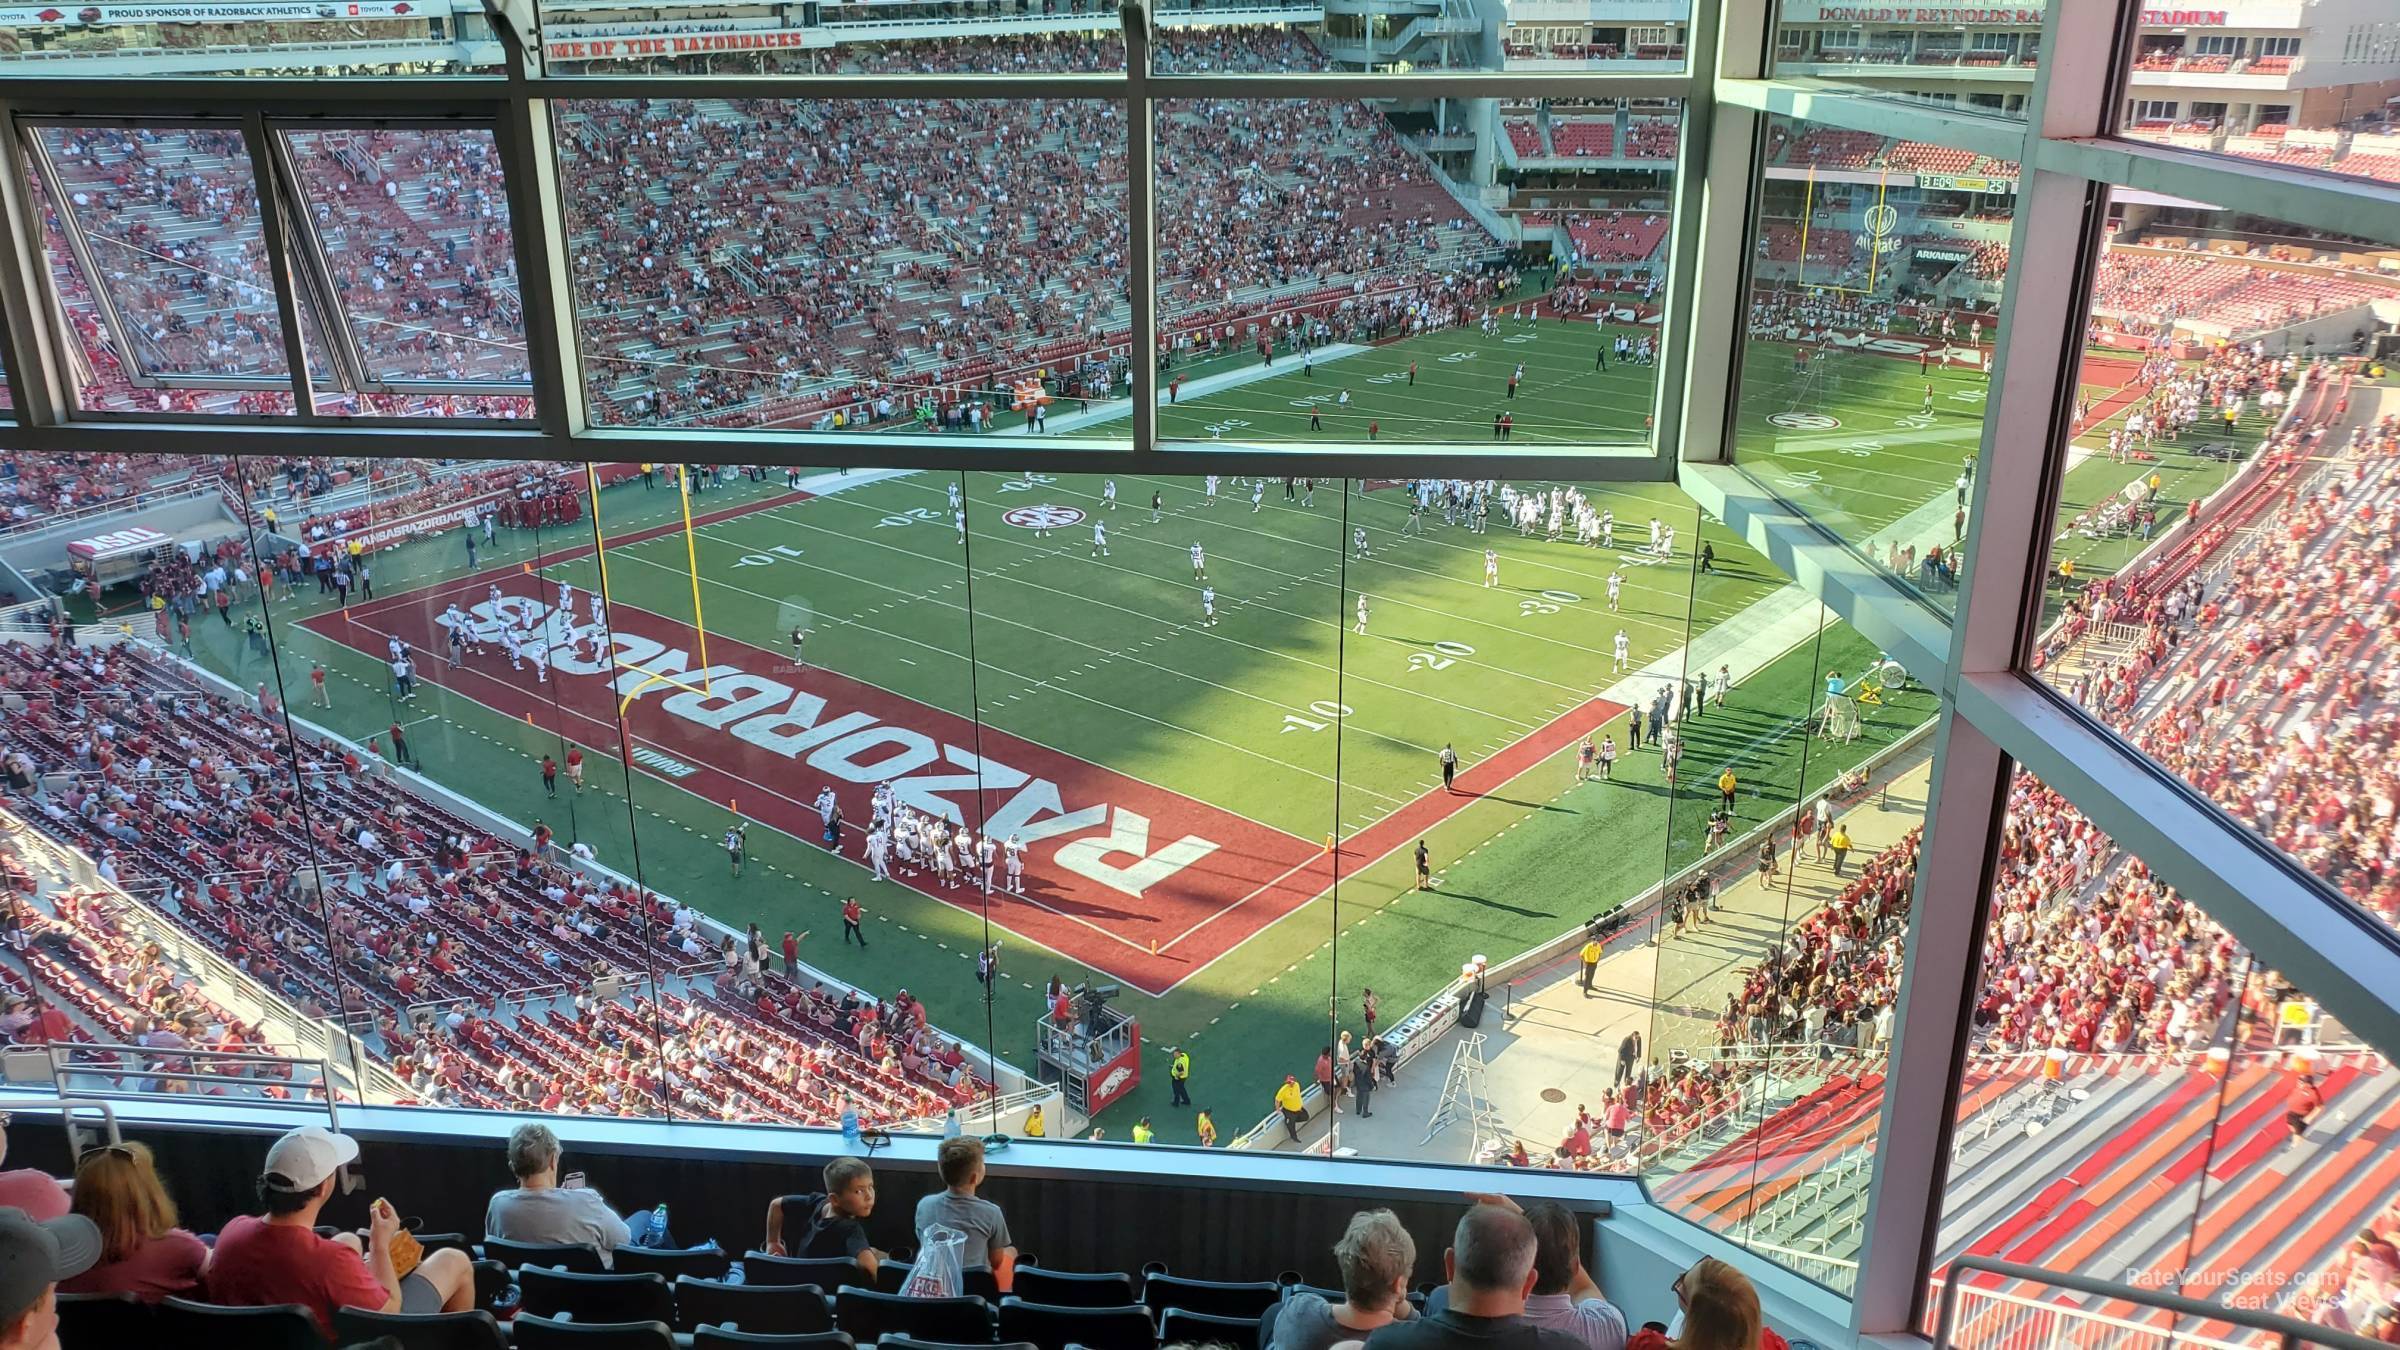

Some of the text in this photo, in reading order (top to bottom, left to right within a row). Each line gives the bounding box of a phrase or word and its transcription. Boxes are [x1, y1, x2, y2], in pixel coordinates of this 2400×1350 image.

[108, 9, 143, 18] PROUD
[145, 9, 191, 17] SPONSOR
[208, 7, 264, 16] RAZORBACK
[266, 6, 311, 15] ATHLETICS
[359, 6, 385, 14] TOYOTA
[1819, 8, 1891, 21] DONALD
[1917, 9, 2010, 22] REYNOLDS
[547, 33, 802, 58] ME OF THE RAZORBACKS
[1988, 181, 2003, 192] 25
[1838, 440, 1884, 457] 30
[872, 507, 942, 529] 20
[729, 544, 805, 569] 10
[1518, 590, 1582, 617] 30
[1407, 641, 1476, 672] 20
[1280, 700, 1354, 734] 10
